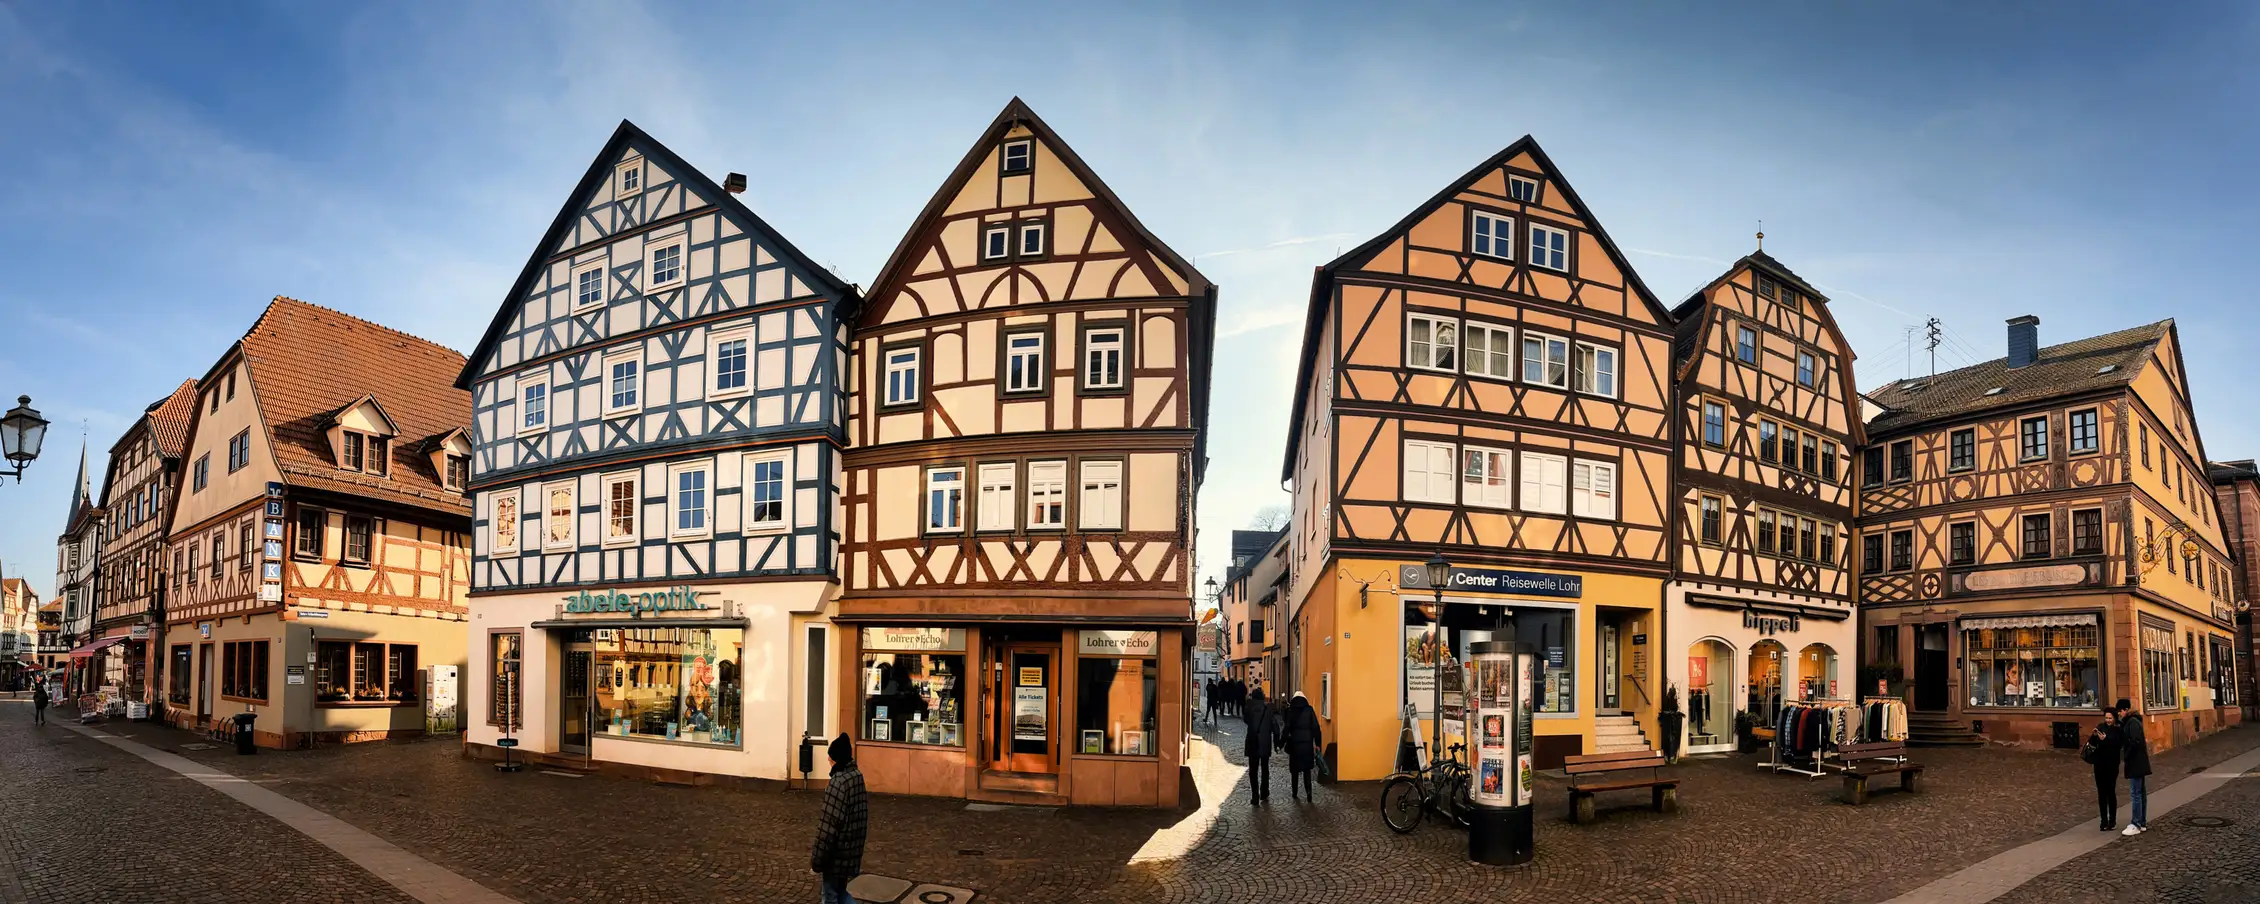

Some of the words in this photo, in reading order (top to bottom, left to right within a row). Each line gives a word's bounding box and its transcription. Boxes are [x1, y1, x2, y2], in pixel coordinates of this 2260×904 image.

[268, 502, 280, 578] BANK
[1455, 571, 1498, 587] Center
[1502, 575, 1557, 590] Reisewelle
[1558, 579, 1581, 592] Lohr
[1743, 608, 1800, 635] hippeli
[886, 634, 915, 643] Lohrer
[920, 635, 941, 644] Echo
[1086, 637, 1119, 647] Lohrer
[1126, 638, 1149, 647] Echo
